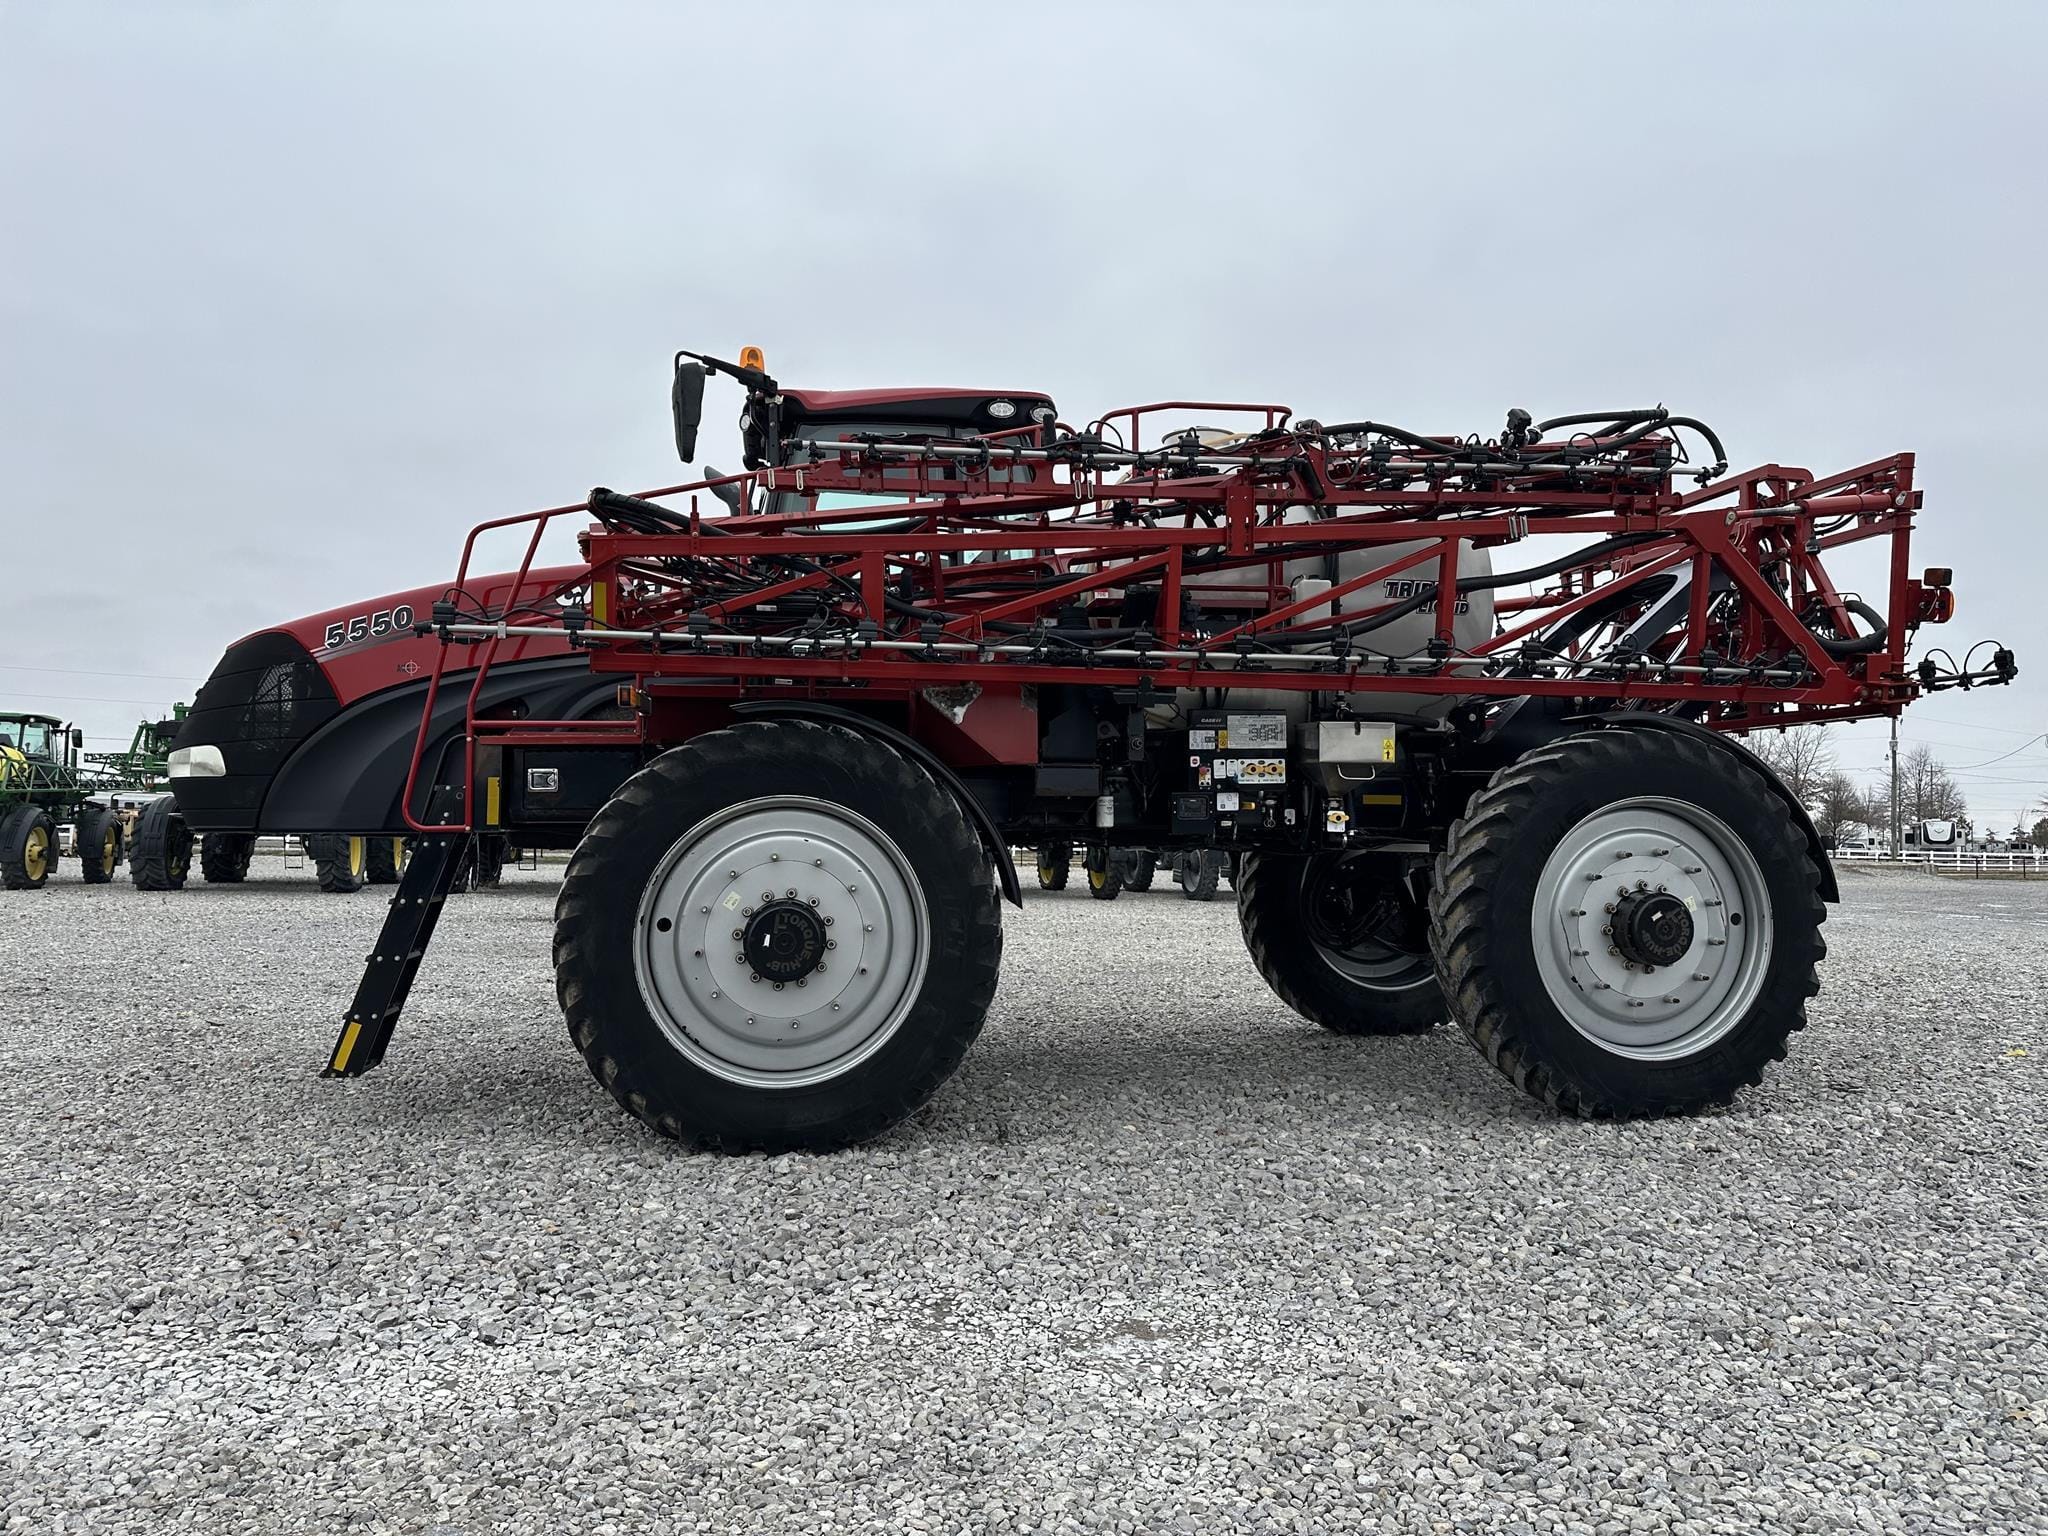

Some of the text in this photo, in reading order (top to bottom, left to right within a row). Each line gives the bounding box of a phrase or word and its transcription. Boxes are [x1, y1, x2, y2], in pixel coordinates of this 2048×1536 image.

[1384, 579, 1468, 600] TRID
[1416, 600, 1469, 615] LIID
[324, 605, 414, 649] 5550
